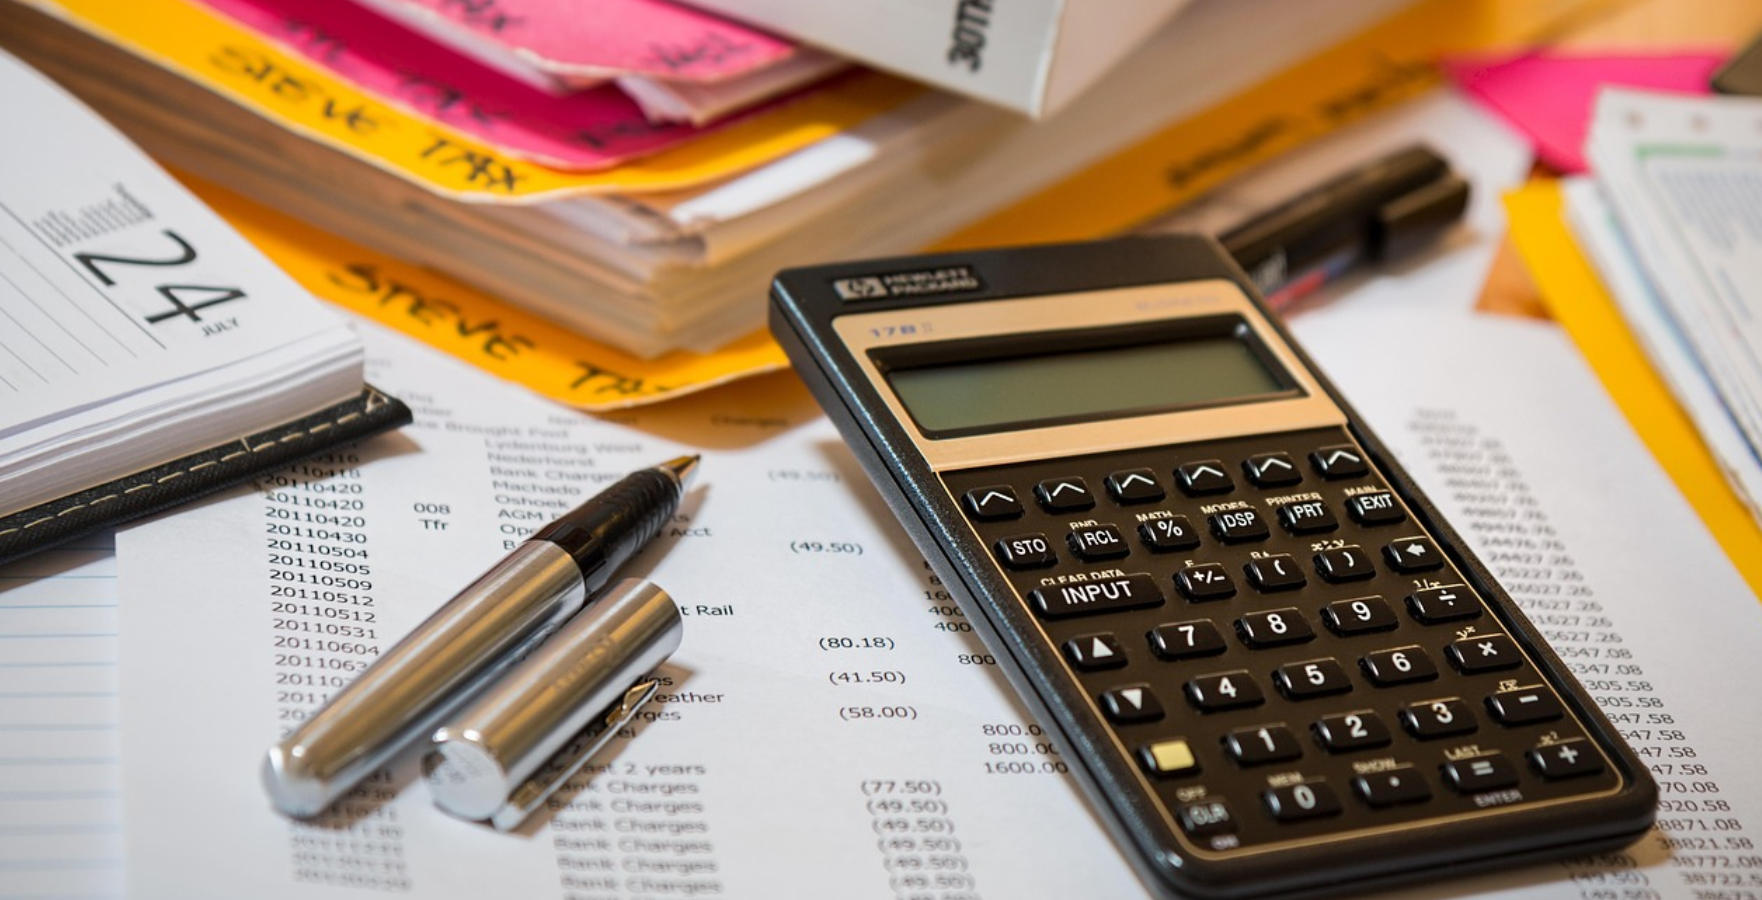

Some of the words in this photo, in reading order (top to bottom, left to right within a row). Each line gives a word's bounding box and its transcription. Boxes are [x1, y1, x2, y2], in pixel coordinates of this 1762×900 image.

[73, 229, 247, 325] 24
[327, 264, 536, 361] STEVE
[200, 317, 241, 337] JULY
[490, 466, 538, 480] Bank
[264, 474, 362, 494] 20110420
[492, 480, 581, 495] Machado
[265, 491, 364, 511] 20110420
[413, 503, 451, 515] 008
[494, 494, 569, 509] Oshoek
[1360, 494, 1394, 510] EXIT
[265, 506, 365, 527] 20110420
[498, 509, 543, 521] AGM
[1294, 502, 1325, 519] PRT
[420, 518, 449, 531] Tfr
[1225, 512, 1256, 528] DSP
[266, 523, 367, 544] 20110430
[670, 527, 713, 538] Acct
[1086, 530, 1119, 547] RCL
[1158, 520, 1183, 539] %
[267, 538, 369, 559] 20110504
[790, 541, 864, 556] (49.50)
[1013, 538, 1047, 556] STO
[268, 554, 371, 575] 20110505
[269, 569, 373, 591] 20110509
[270, 585, 375, 607] 20110512
[1061, 580, 1133, 605] INPUT
[272, 602, 376, 623] 20110512
[697, 605, 734, 616] Rail
[1352, 601, 1372, 621] 9
[273, 618, 378, 640] 20110531
[1267, 613, 1287, 634] 8
[819, 637, 895, 650] (80.18)
[1178, 625, 1195, 647] 7
[1544, 629, 1623, 643] 5627.26
[274, 635, 380, 656] 20110604
[1554, 646, 1633, 659] 5547.08
[1392, 652, 1411, 672] 6
[829, 671, 906, 685] (41.50)
[1305, 664, 1325, 685] 5
[1218, 676, 1237, 699] 4
[649, 692, 724, 704] eather
[1595, 696, 1664, 708] 905.58
[839, 706, 917, 720] (58.00)
[1432, 702, 1453, 724] 3
[1345, 715, 1368, 738] 2
[1258, 726, 1276, 752] 1
[1445, 745, 1480, 760] LAST
[625, 763, 637, 775] 2
[646, 764, 707, 777] years
[984, 761, 1068, 775] 1600.00
[1651, 763, 1708, 776] 47.58
[559, 781, 599, 794] ank
[607, 779, 700, 797] Charges
[860, 779, 942, 797] (77.50)
[1293, 784, 1316, 810] 0
[610, 798, 705, 815] Charges
[866, 798, 948, 816] (49.50)
[1473, 789, 1523, 808] ENTER
[871, 817, 955, 836] (49.50)
